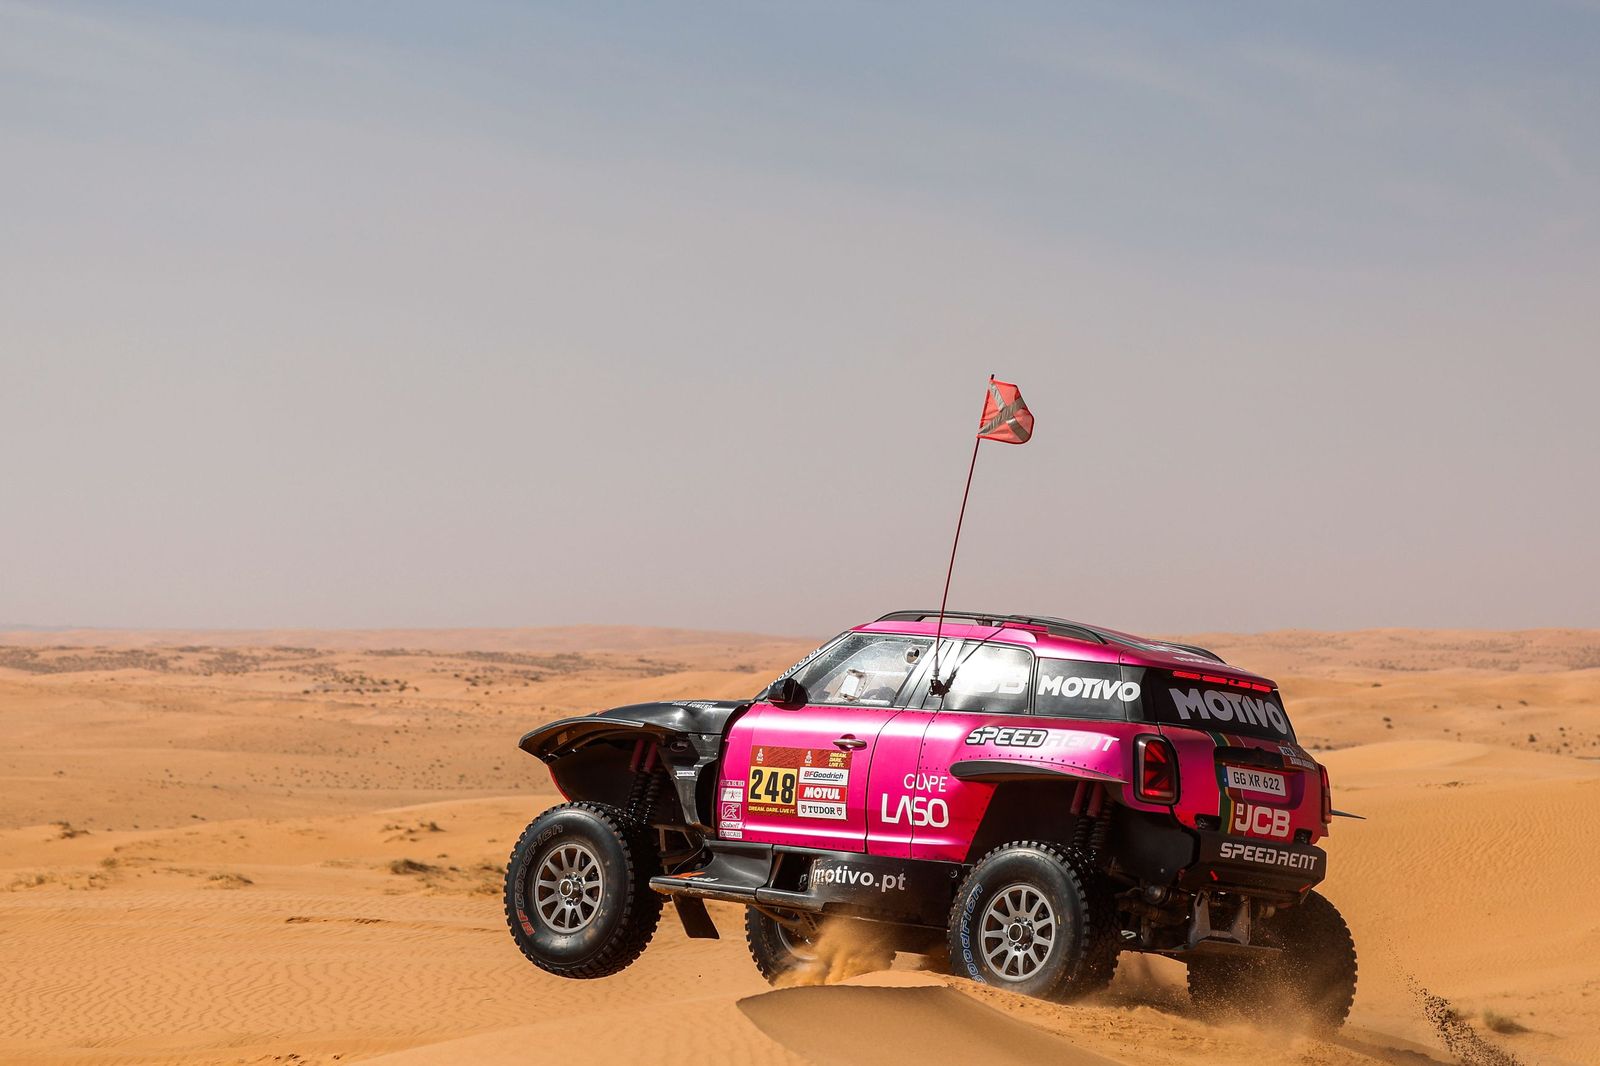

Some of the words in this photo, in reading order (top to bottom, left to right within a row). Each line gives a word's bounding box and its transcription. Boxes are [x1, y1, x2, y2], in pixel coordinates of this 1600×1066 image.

[1038, 675, 1141, 702] MOTIVO
[1168, 688, 1288, 735] MOTIVO
[750, 769, 795, 804] 248
[804, 770, 844, 780] BFGoodrich
[1233, 771, 1246, 785] GG
[1248, 773, 1261, 788] XR
[1263, 776, 1280, 791] 622
[803, 788, 840, 800] MOTUL
[808, 805, 835, 815] TUDOR
[881, 793, 949, 828] LASO
[1235, 803, 1290, 838] JCB
[1220, 842, 1318, 870] SPEEDRENT
[515, 824, 563, 936] BFGoodrich
[813, 866, 906, 893] motivo.pt
